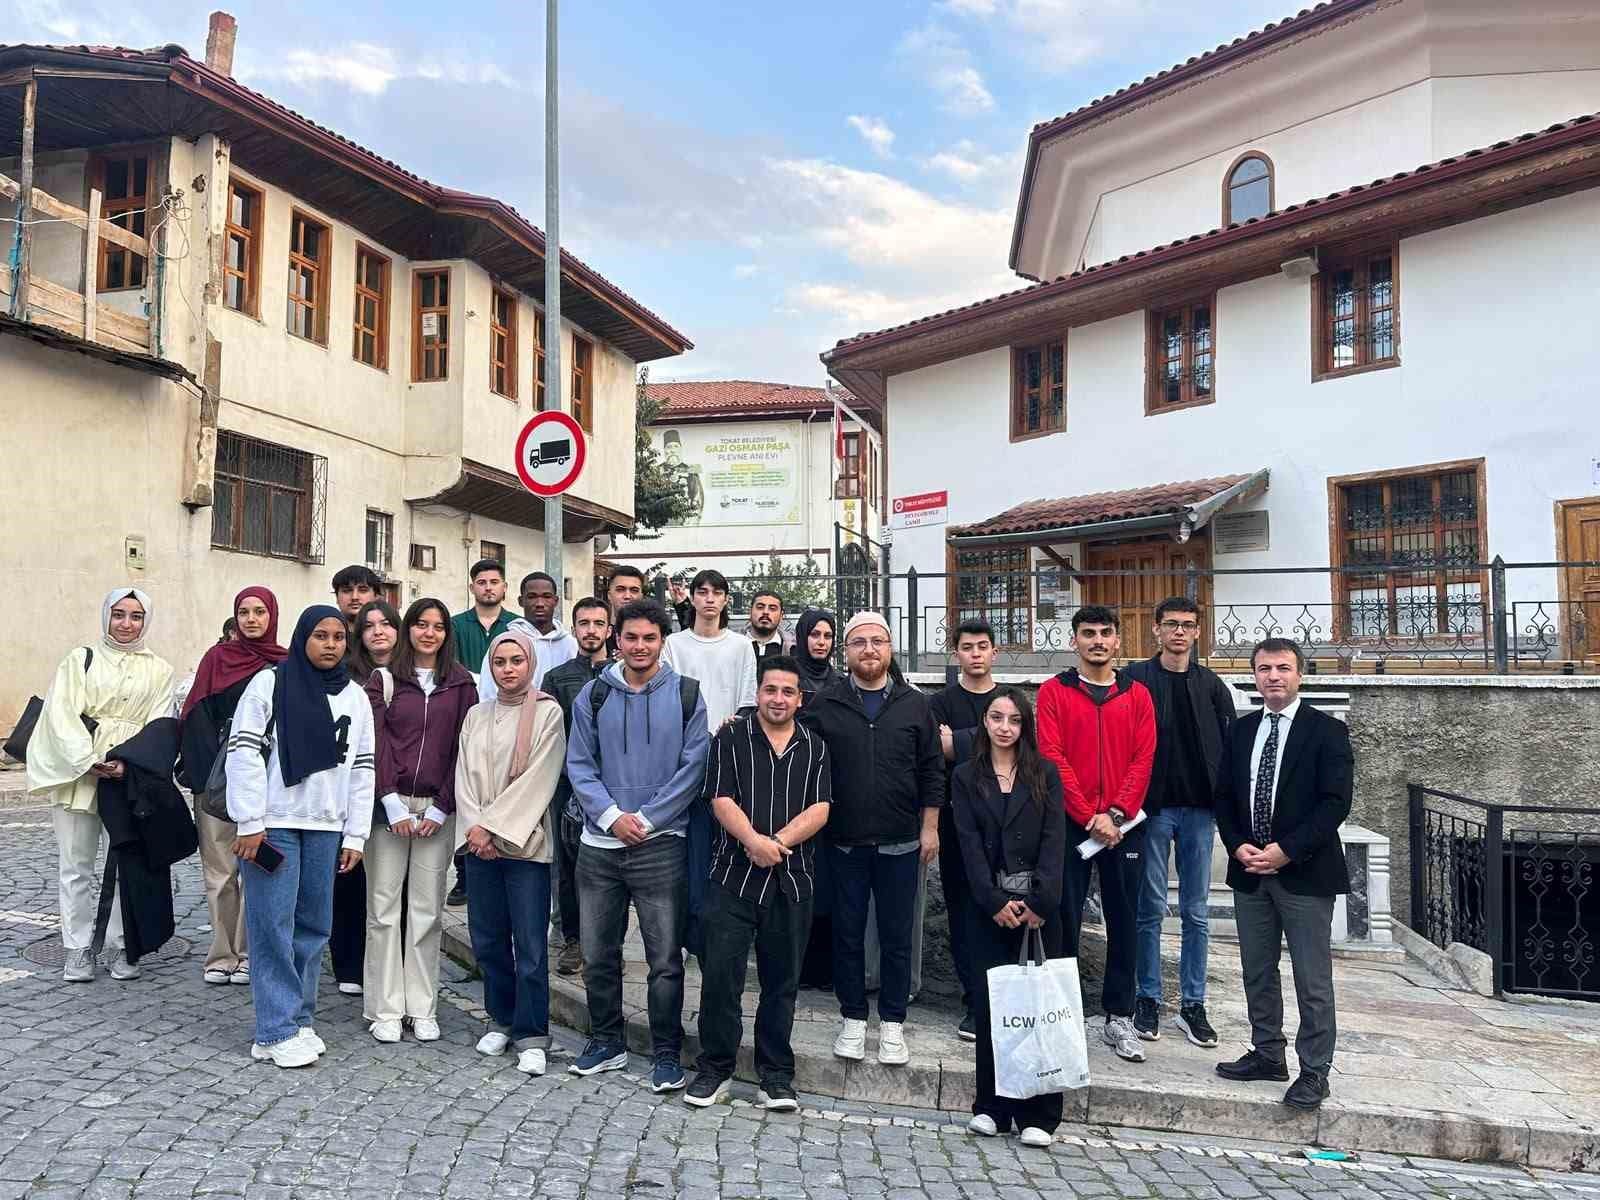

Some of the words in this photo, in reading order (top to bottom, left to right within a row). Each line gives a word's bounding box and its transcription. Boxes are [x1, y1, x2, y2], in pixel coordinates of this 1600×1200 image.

[729, 442, 764, 452] OSMAN
[766, 441, 790, 453] PAŞA
[718, 453, 749, 461] PLEVNE
[1002, 1015, 1036, 1029] LCW
[1040, 1007, 1072, 1026] HOME
